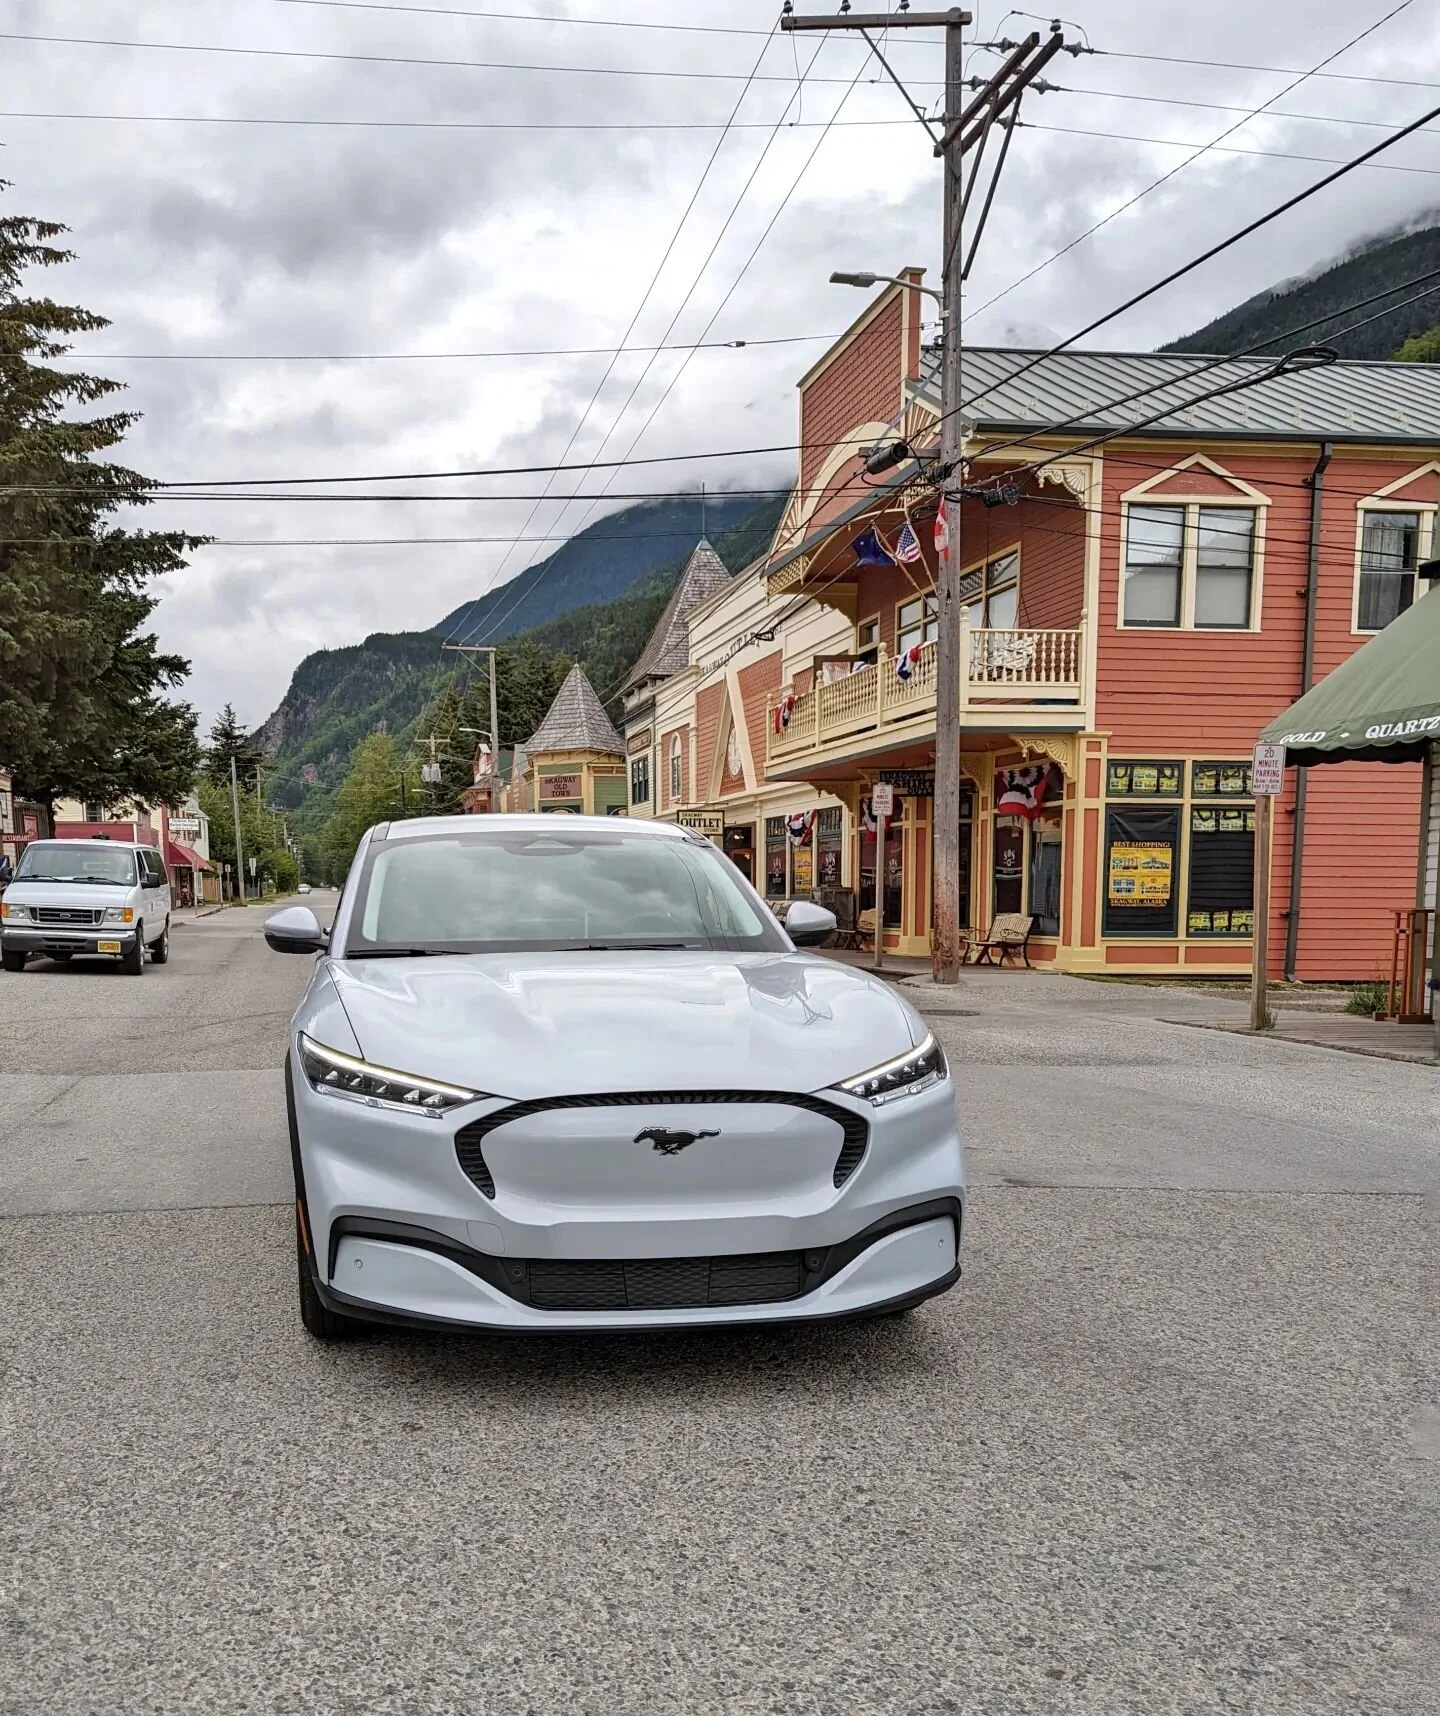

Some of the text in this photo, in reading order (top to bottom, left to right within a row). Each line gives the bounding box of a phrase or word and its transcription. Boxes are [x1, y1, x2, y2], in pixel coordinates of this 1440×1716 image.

[1279, 716, 1440, 745] GOLD QUARTZ
[1264, 749, 1275, 758] 20
[1258, 760, 1279, 768] MINUTE
[1255, 769, 1280, 778] PARKING
[545, 775, 577, 785] SKAGWAY
[680, 818, 722, 828] OUTLET
